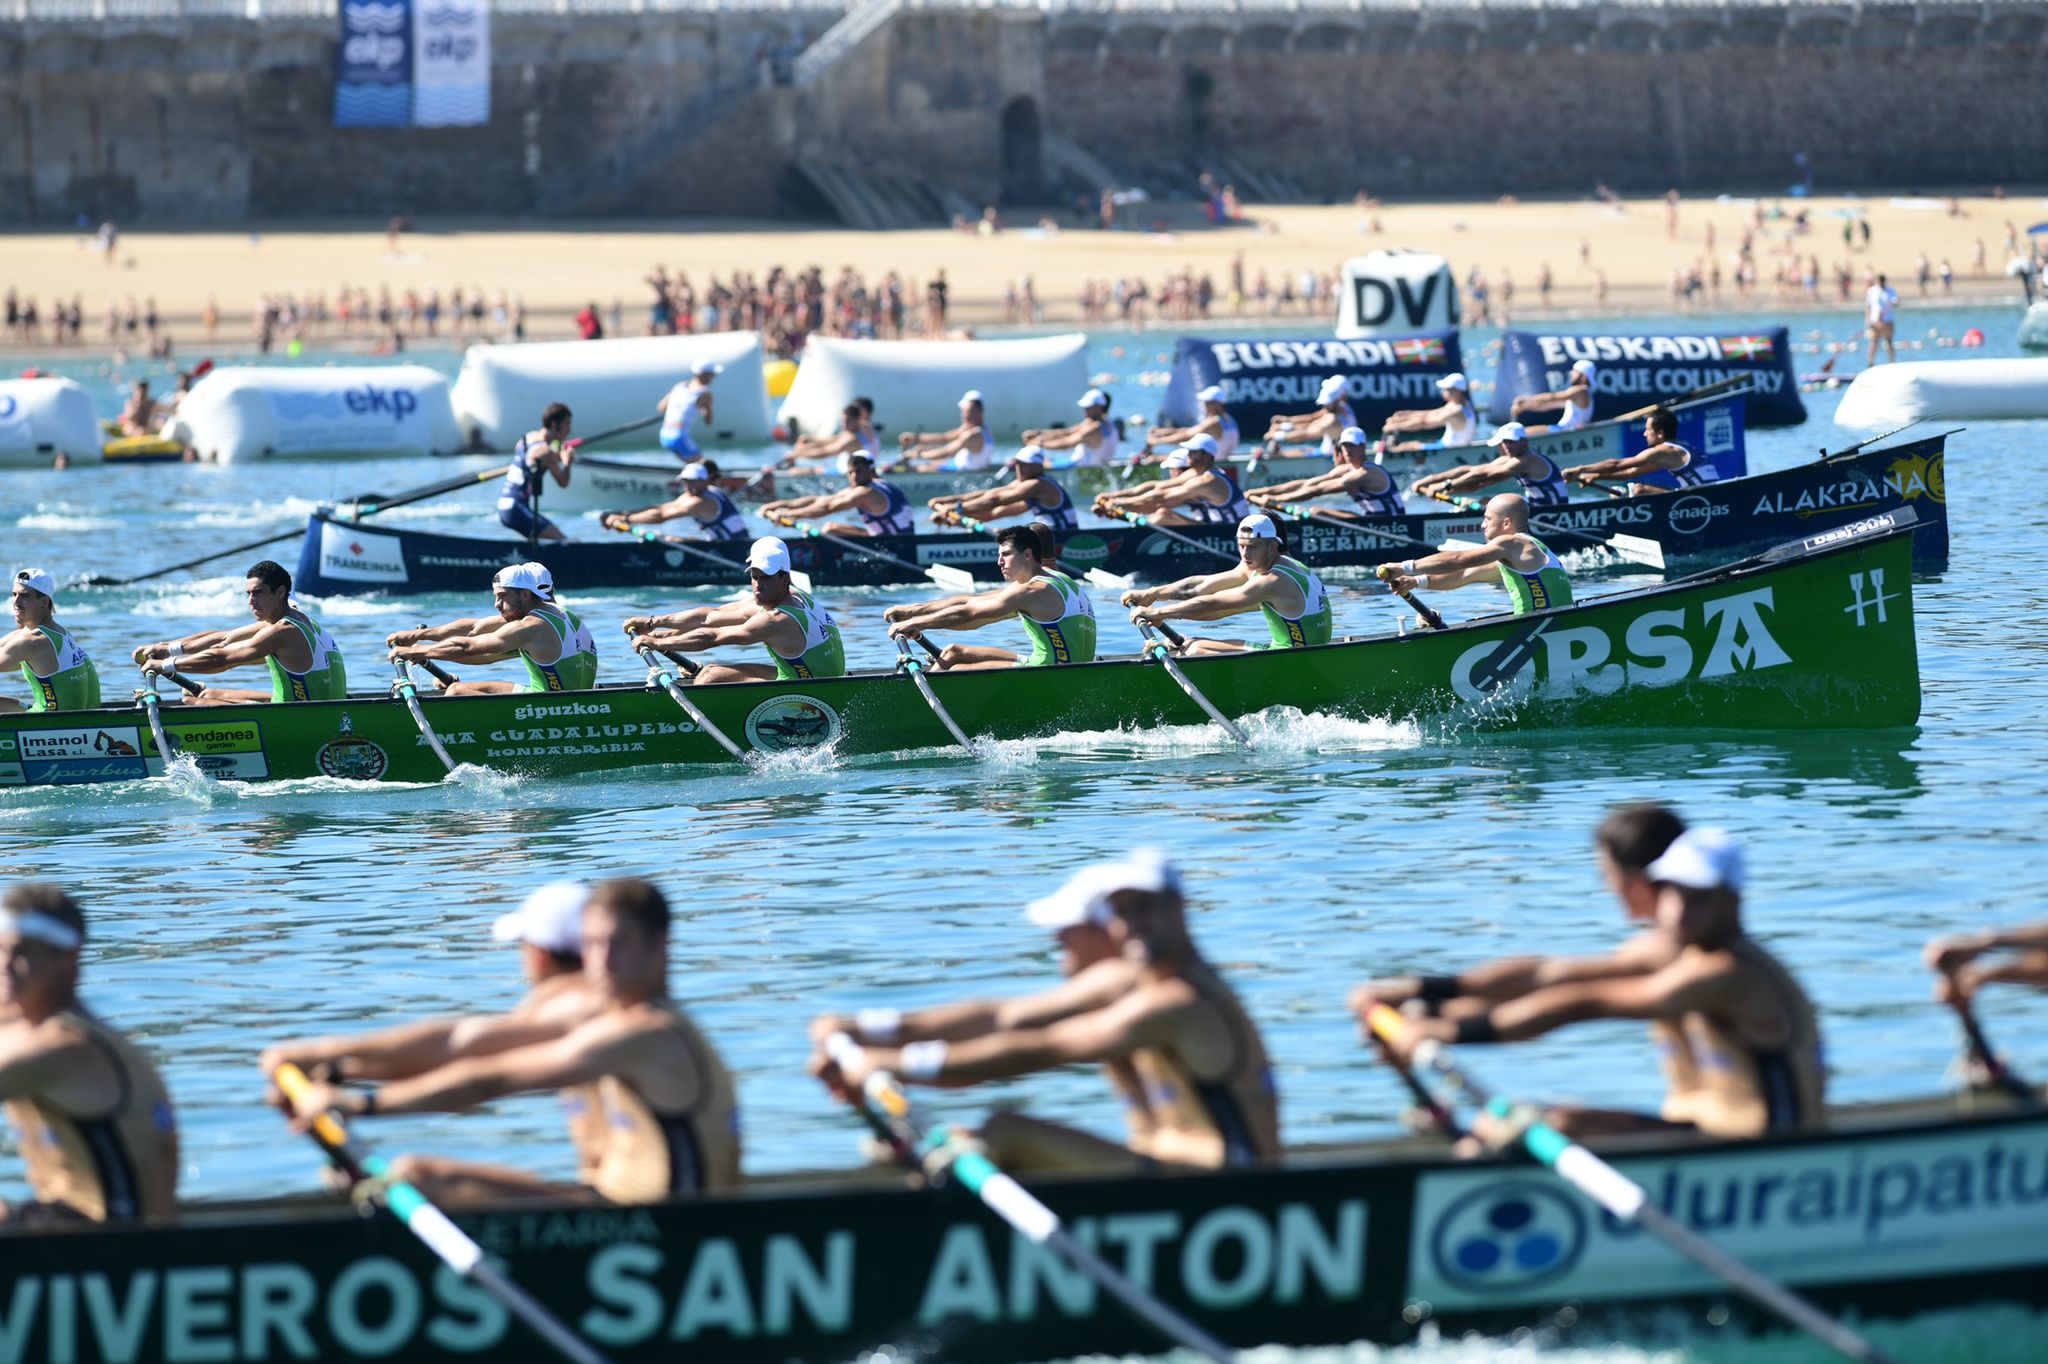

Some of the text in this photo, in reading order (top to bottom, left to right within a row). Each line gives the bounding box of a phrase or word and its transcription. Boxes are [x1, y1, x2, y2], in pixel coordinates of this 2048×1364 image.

[1354, 273, 1440, 327] DV
[1211, 340, 1396, 373] EUSKADI
[1537, 335, 1723, 364] EUSKADI
[345, 384, 418, 423] ekp
[1753, 471, 1928, 516] ALAKRANA
[1528, 503, 1654, 536] CAMPOS
[515, 702, 611, 720] gipuzkoa
[22, 734, 88, 747] Imanol
[25, 748, 67, 757] Lasa
[184, 730, 254, 743] endanea
[0, 1200, 1366, 1364] VIVEROS SAN ANTON
